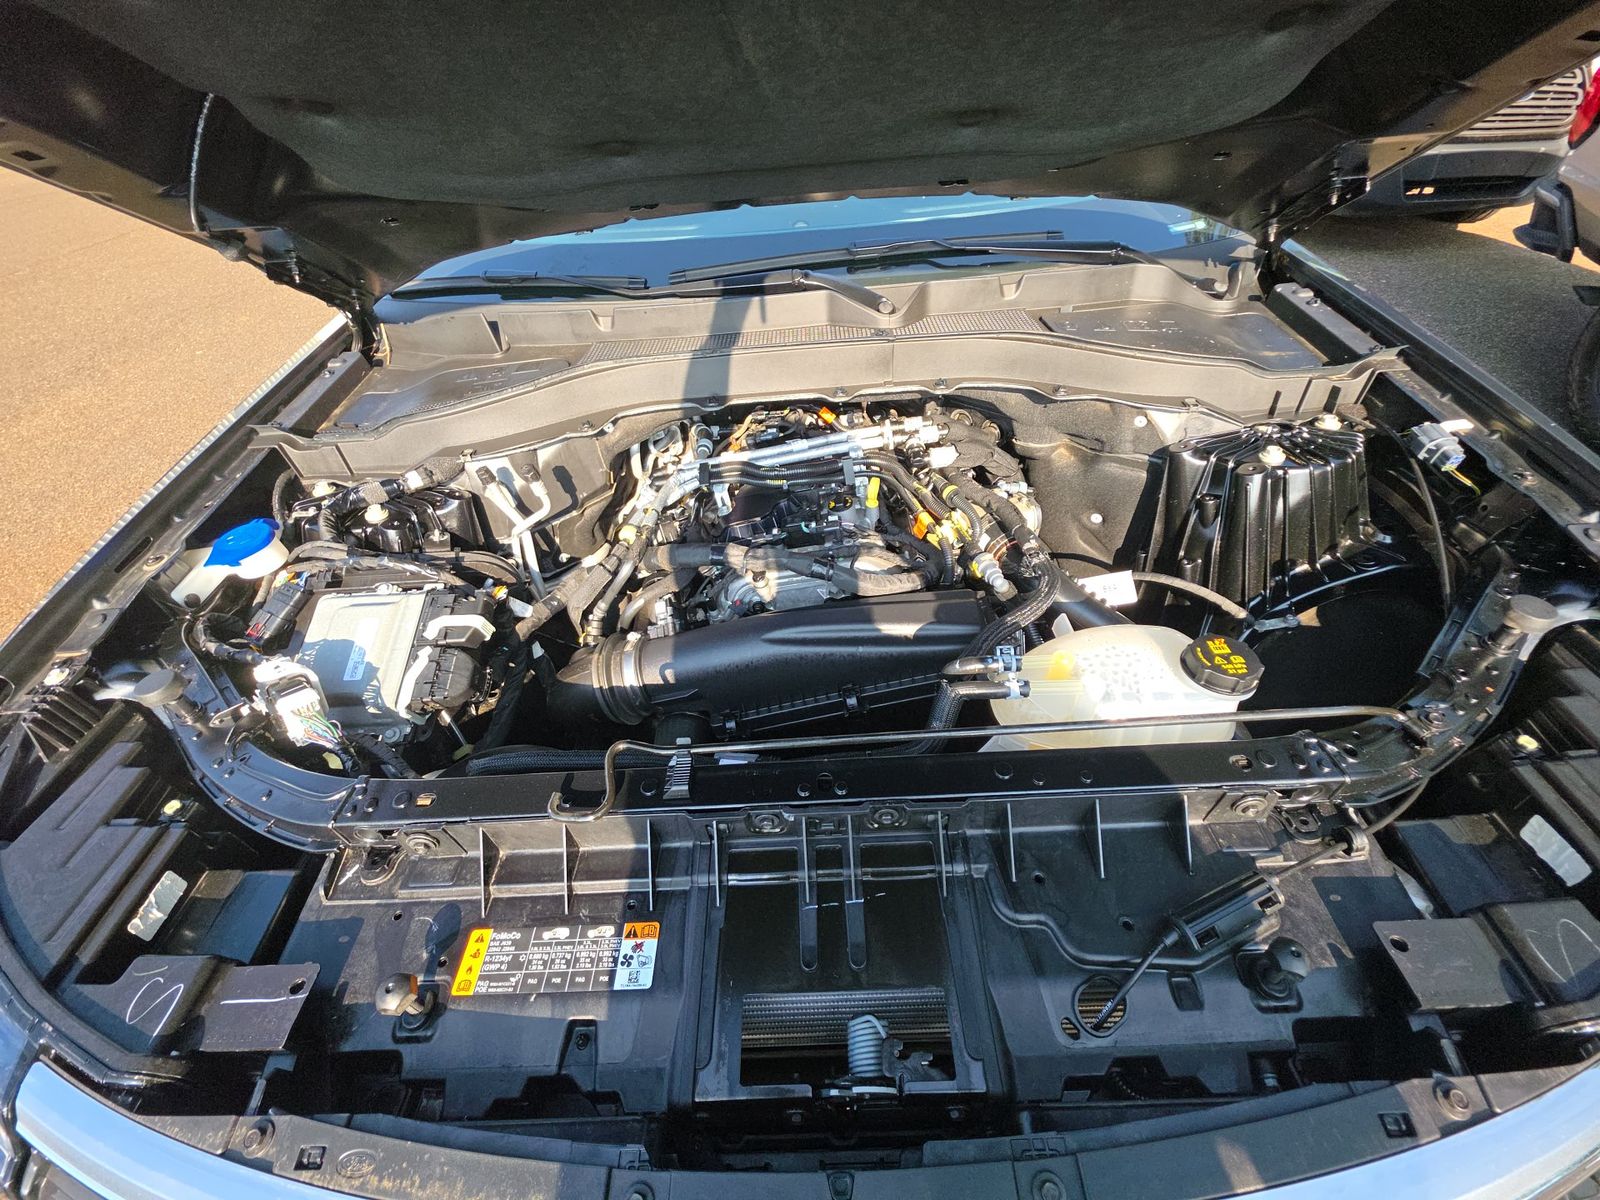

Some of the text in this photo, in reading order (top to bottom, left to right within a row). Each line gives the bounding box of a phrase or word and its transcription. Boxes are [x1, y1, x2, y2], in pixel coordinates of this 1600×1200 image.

[491, 931, 521, 940] FoMoCo
[485, 954, 513, 962] R-1234yf
[482, 963, 508, 972] (GWP 4)
